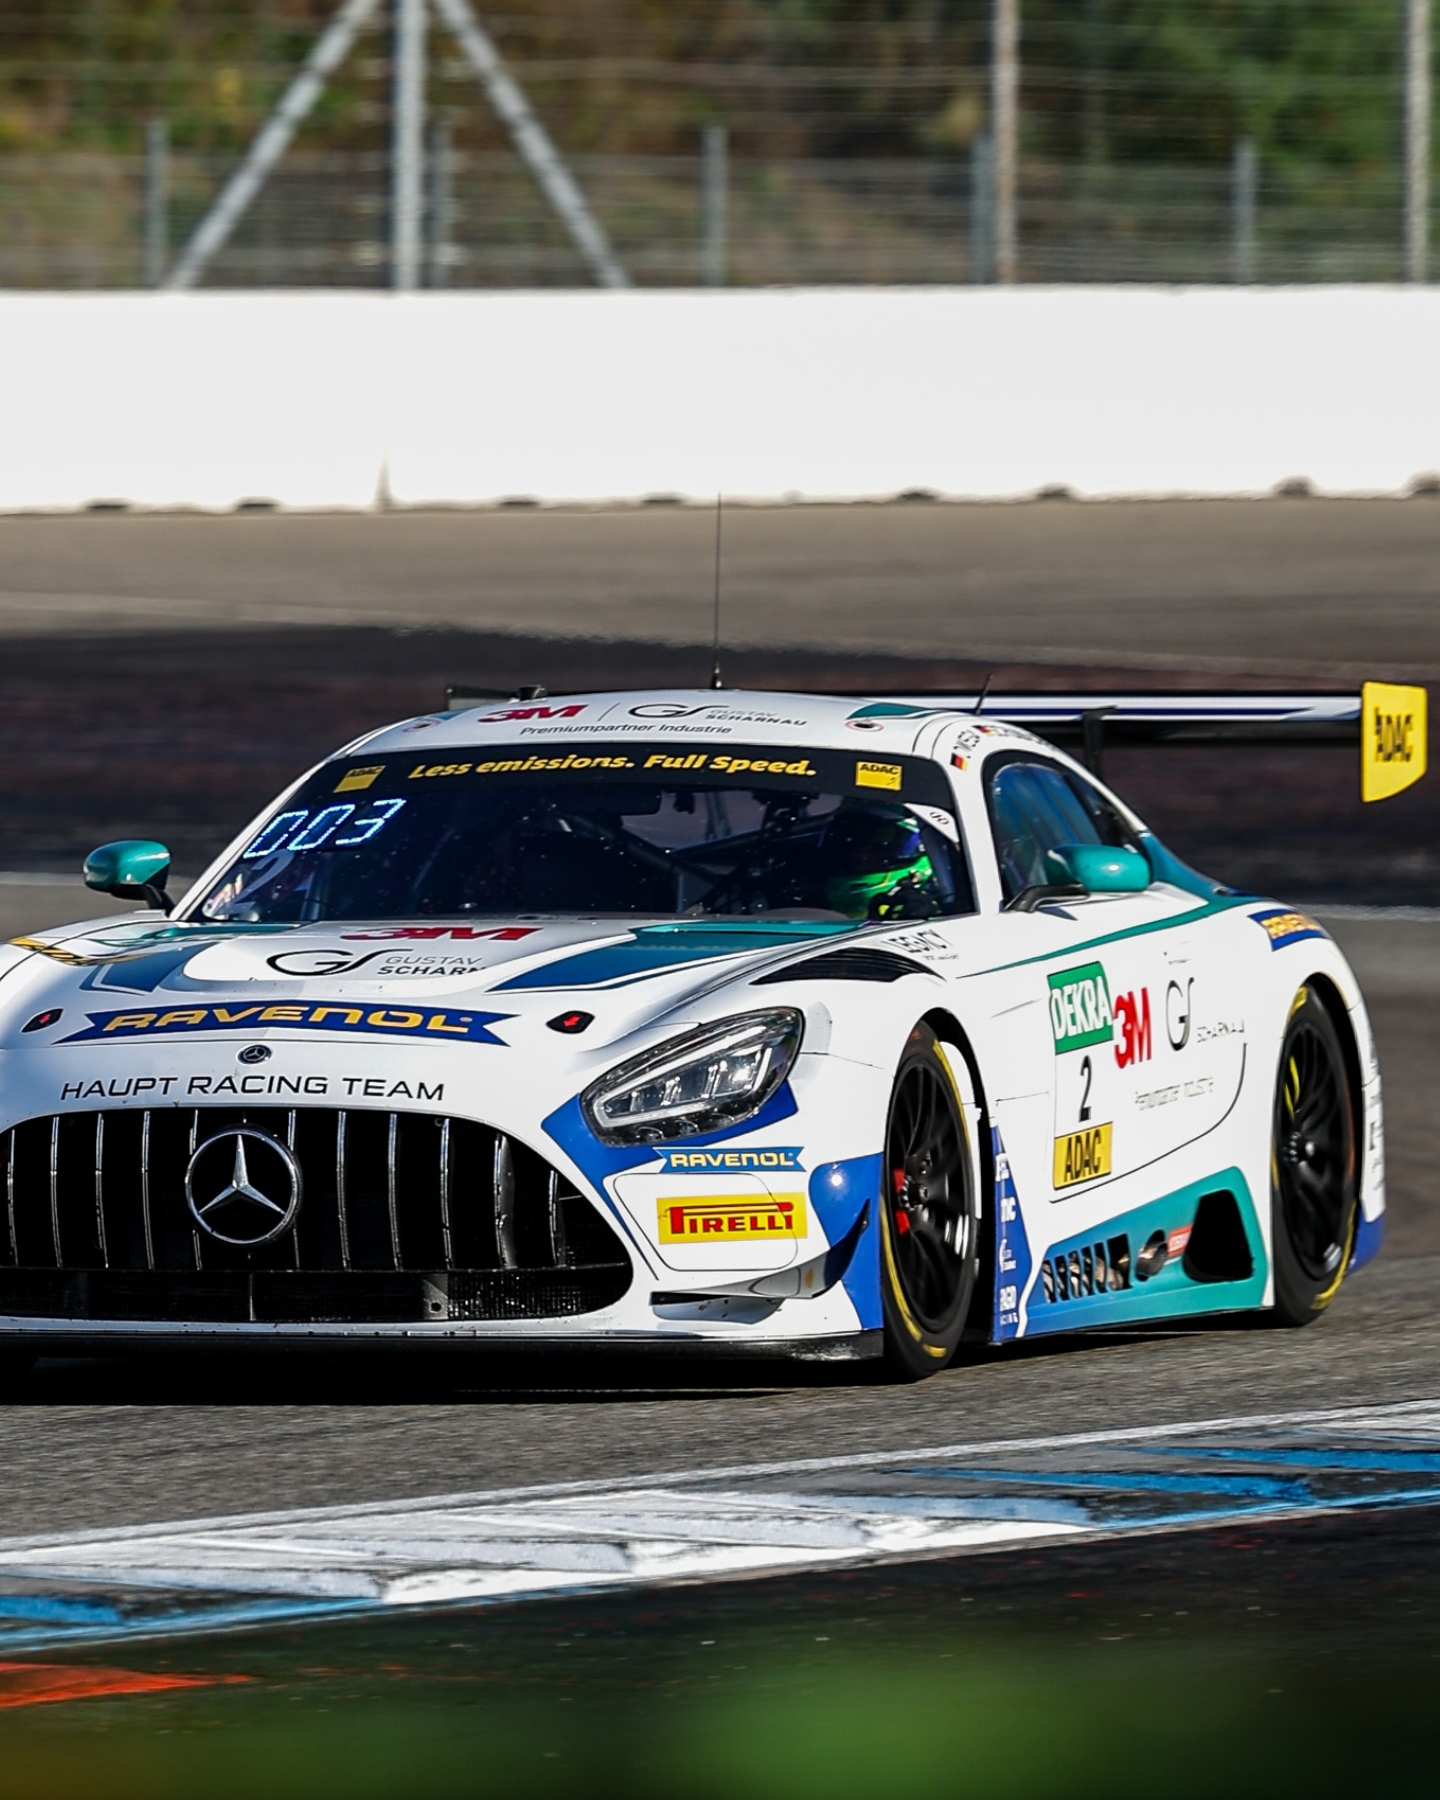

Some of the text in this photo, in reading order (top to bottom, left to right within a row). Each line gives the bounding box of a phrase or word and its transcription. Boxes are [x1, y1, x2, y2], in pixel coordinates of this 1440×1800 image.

[477, 703, 589, 723] 3M
[705, 713, 808, 726] SCHARNAU
[520, 723, 733, 736] Premiumpartner Industrie
[1374, 706, 1413, 762] ADAC
[345, 765, 386, 778] ADAC
[408, 754, 817, 780] Less emissions. Full Speed.
[859, 763, 901, 776] ADAC
[243, 798, 407, 860] 003
[340, 927, 544, 940] 3M
[385, 955, 483, 965] GUSTAV
[102, 1005, 470, 1034] RAVENOL
[1049, 975, 1113, 1041] DEKRA
[1113, 986, 1152, 1069] 3M
[60, 1075, 445, 1101] HAUPT RACING TEAM
[1078, 1055, 1092, 1122] 2
[669, 1152, 795, 1168] RAVENOL
[1063, 1128, 1102, 1183] ADAC
[668, 1201, 795, 1235] PIRELLI
